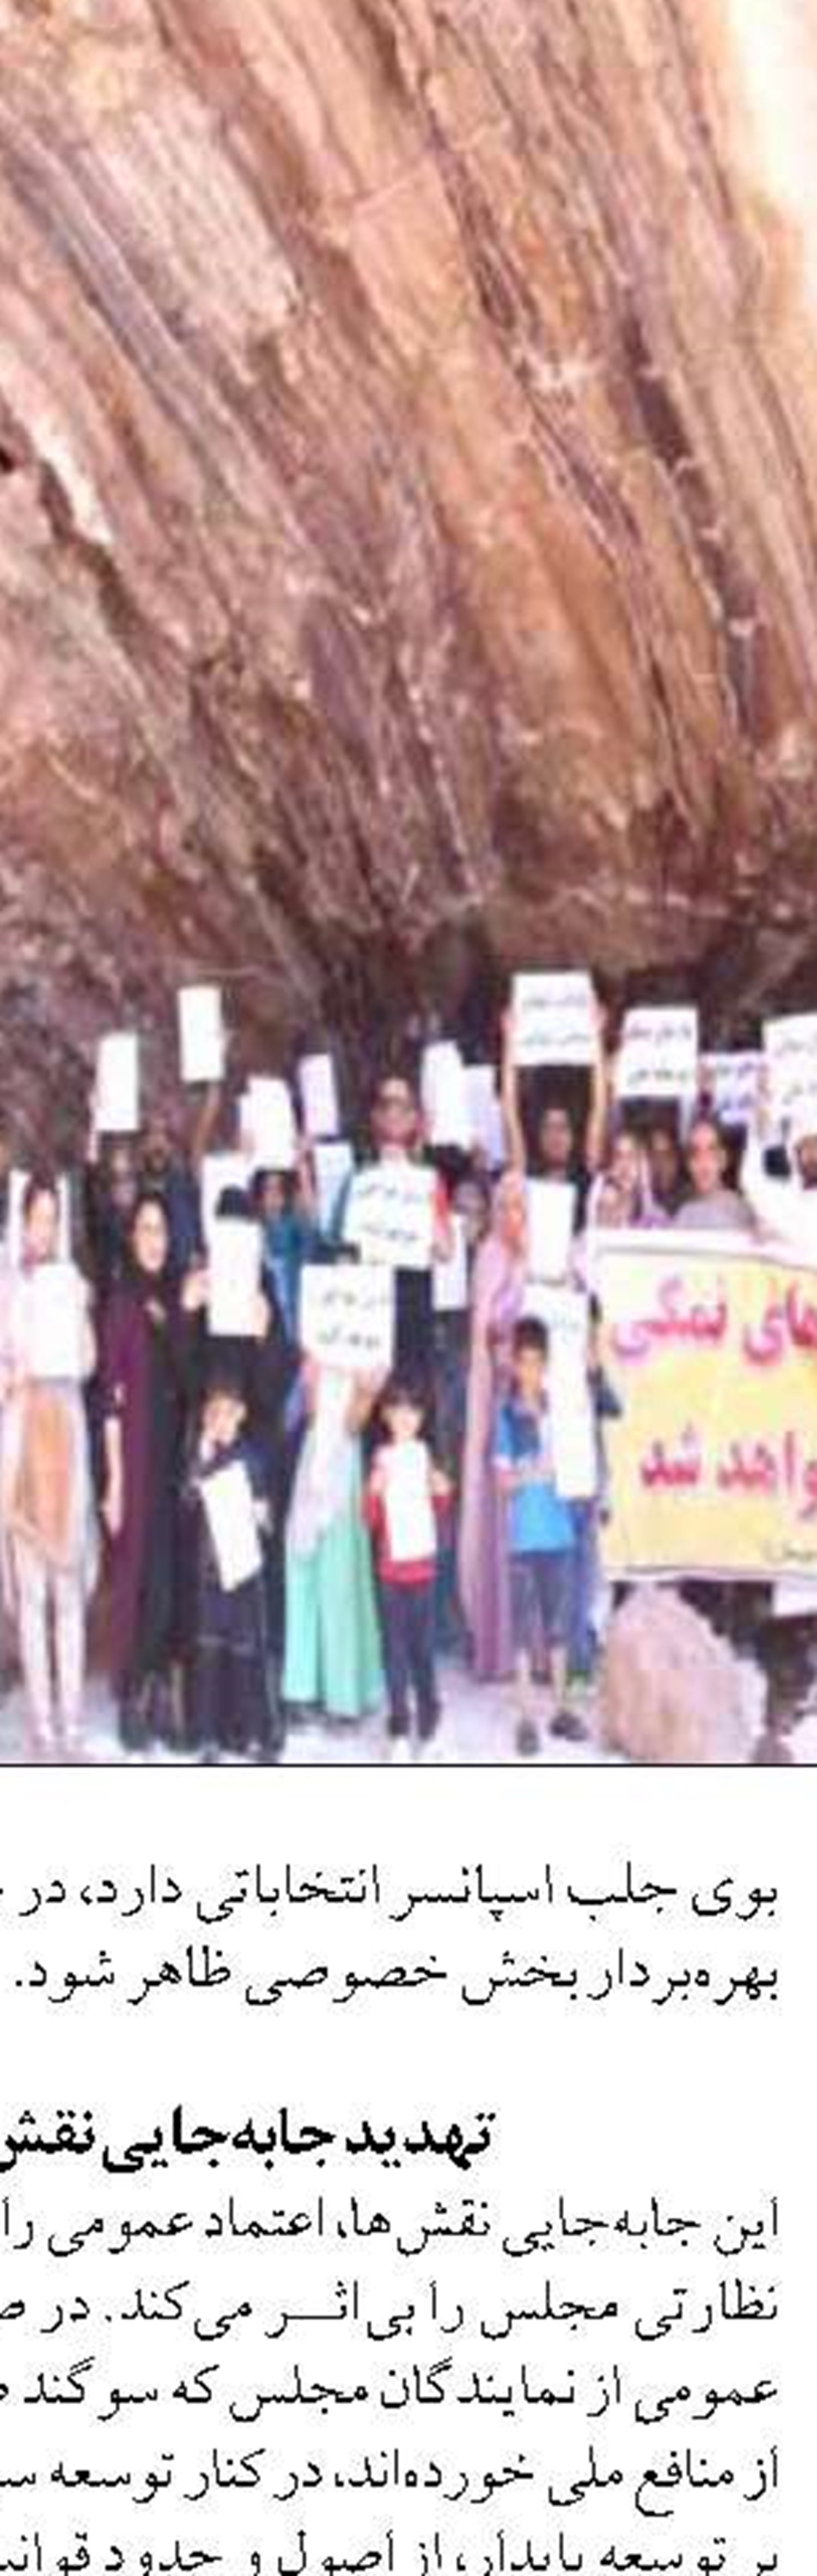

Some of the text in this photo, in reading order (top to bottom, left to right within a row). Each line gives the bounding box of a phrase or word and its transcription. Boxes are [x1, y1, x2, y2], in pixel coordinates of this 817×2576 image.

[640, 1420, 700, 1487] شد
[19, 1861, 778, 1925] بوی جلب اسپانسر انتخاباتی دارد، در
[15, 1950, 115, 2003] شود.
[127, 1945, 231, 2006] ظاهر
[245, 1955, 447, 2006] خصوصی
[461, 1951, 577, 2006] بخش
[345, 2112, 496, 2171] تهدید
[2, 2196, 34, 2250] را
[47, 2212, 193, 2258] عمومی
[204, 2197, 323, 2239] اعتماد
[713, 2196, 778, 2257] این
[40, 2296, 90, 2334] در
[429, 2280, 464, 2334] را
[480, 2280, 618, 2341] مجلس
[635, 2278, 778, 2342] نظارتی
[23, 2356, 778, 2426] عمومی از نمایندگان مجلس که سوگند
[50, 2453, 174, 2504] توسعه
[183, 2448, 266, 2501] کنار
[272, 2462, 323, 2501] در
[548, 2446, 624, 2507] ملی
[635, 2448, 734, 2518] منافع
[743, 2445, 778, 2501] از
[105, 2540, 222, 2576] حدود
[600, 2537, 726, 2576] توسعه
